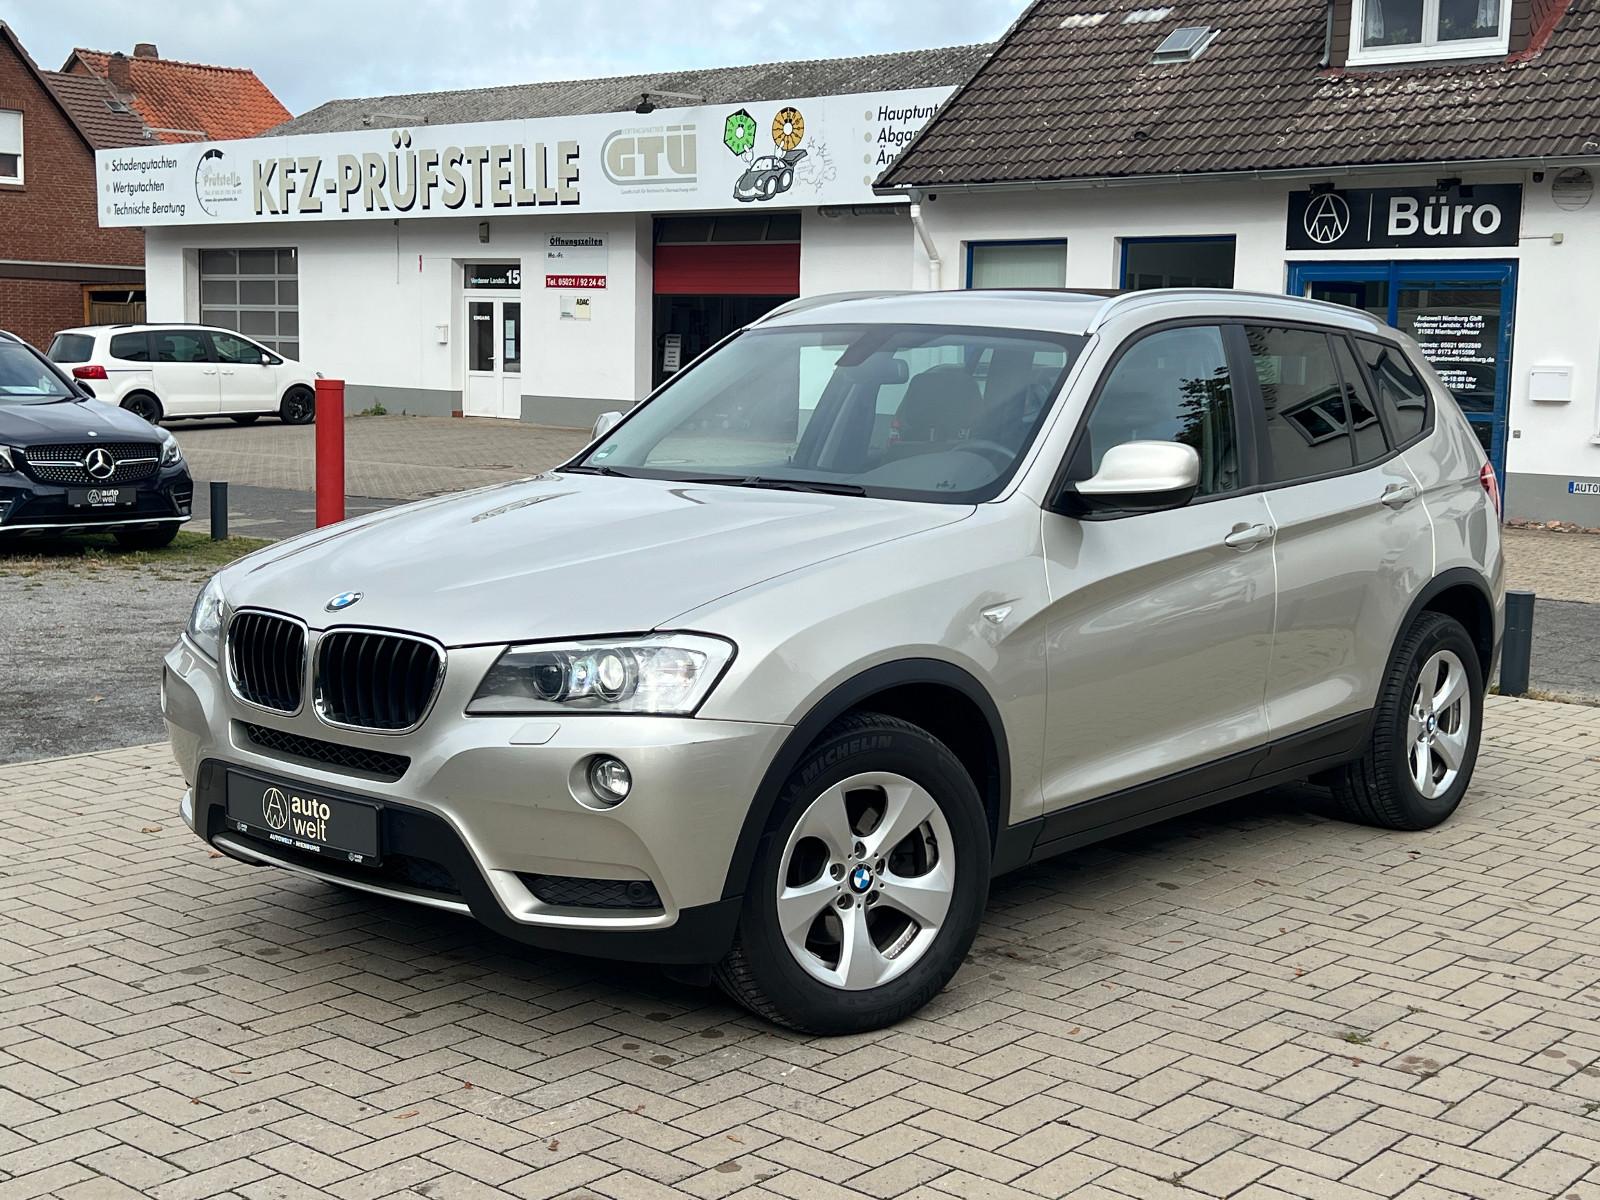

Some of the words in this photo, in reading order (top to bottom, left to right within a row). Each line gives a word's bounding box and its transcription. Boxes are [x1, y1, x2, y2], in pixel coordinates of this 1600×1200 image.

[607, 124, 697, 177] GTÜ
[876, 145, 904, 165] Än
[112, 155, 177, 173] Schadengutachten
[253, 129, 580, 215] KFZ-PRÜFSTELLE
[112, 179, 165, 196] Wertgutachten
[113, 201, 150, 215] Technische
[152, 201, 186, 216] Beratung
[1388, 196, 1502, 236] Büro
[549, 236, 603, 247] Öffnungszeiten
[547, 277, 557, 286] Tel.
[558, 278, 576, 286] 05021
[581, 278, 588, 287] 92
[589, 278, 597, 287] 24
[597, 279, 606, 287] 45
[576, 298, 590, 306] ADAC
[1442, 315, 1469, 323] Nienburg
[101, 489, 119, 497] auto
[1575, 483, 1600, 494] AUTO
[801, 735, 893, 784] MICHELIN
[291, 796, 331, 821] auto
[292, 817, 327, 842] welt
